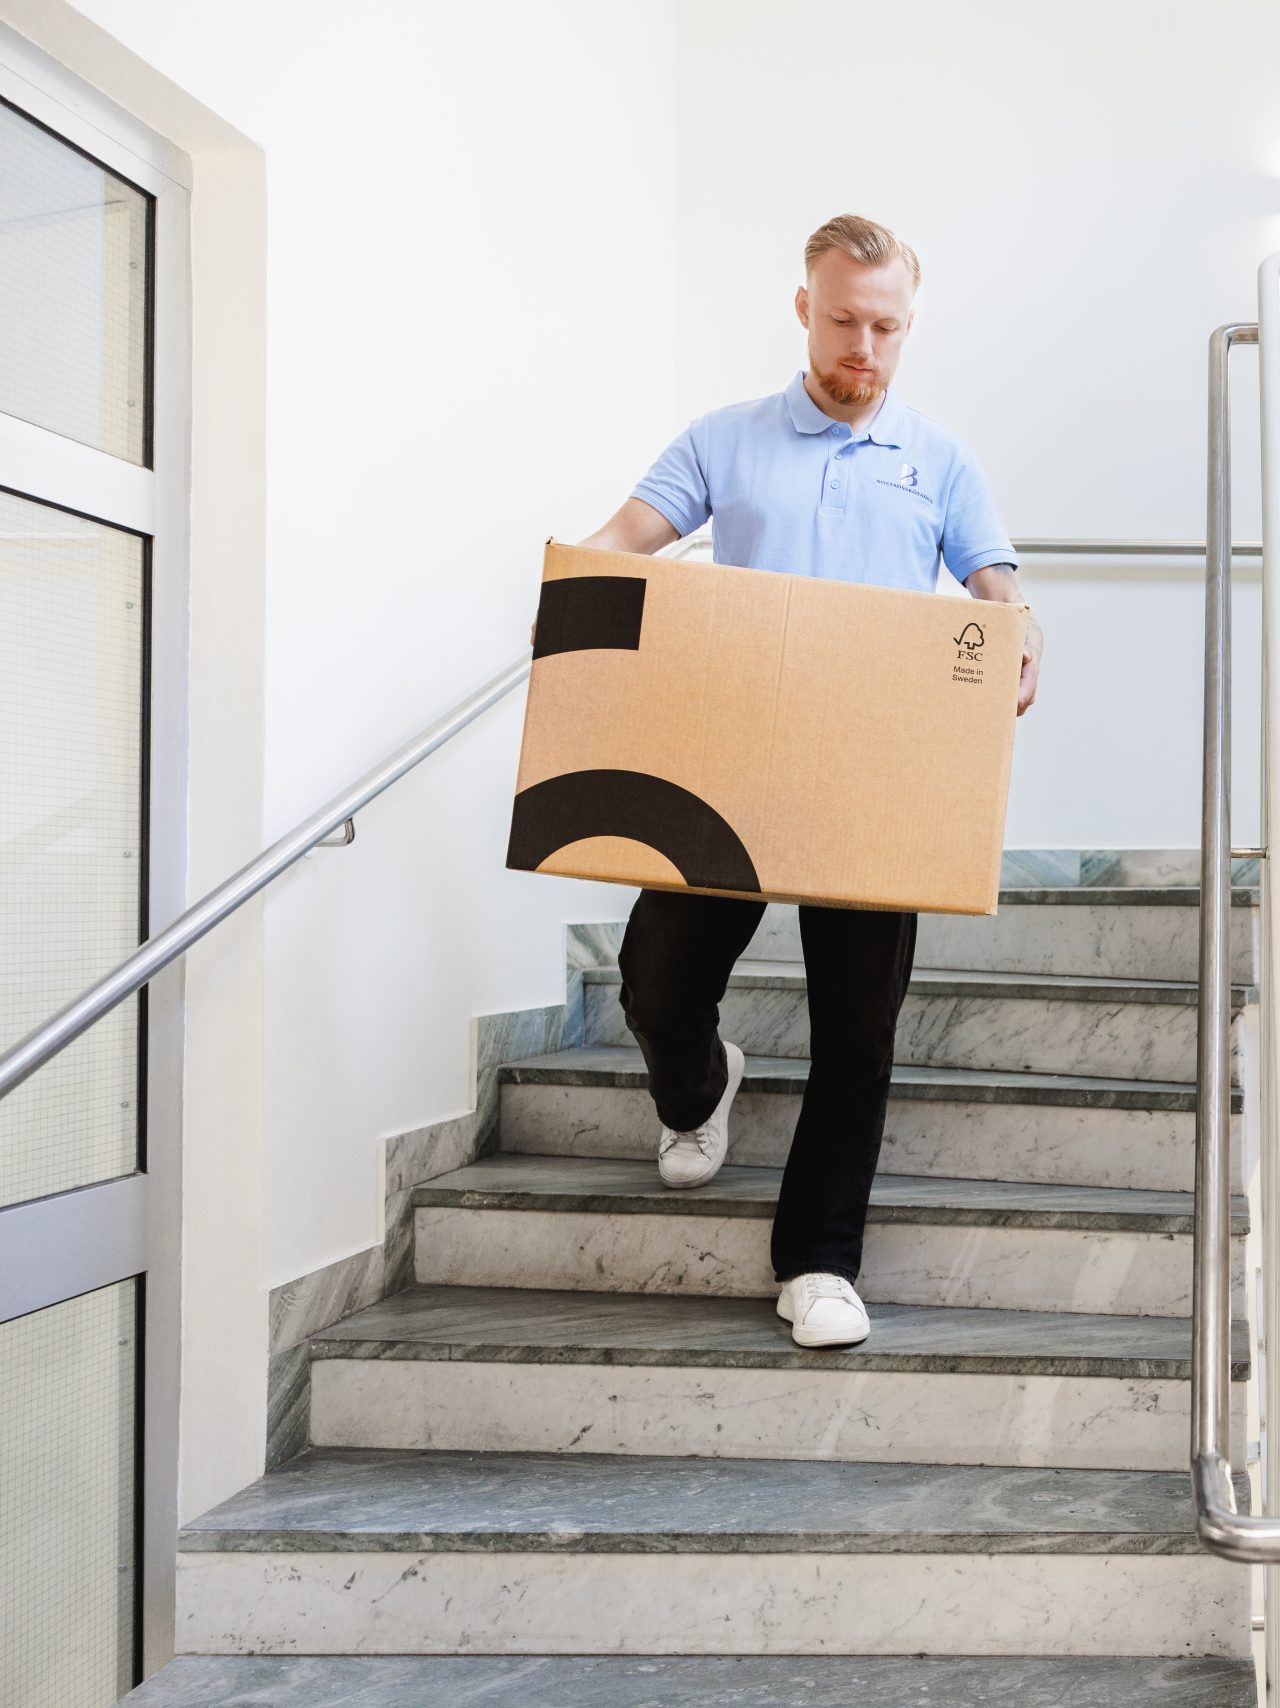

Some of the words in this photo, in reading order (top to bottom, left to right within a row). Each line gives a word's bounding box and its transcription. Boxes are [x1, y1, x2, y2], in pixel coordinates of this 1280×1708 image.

[957, 650, 983, 662] FSC
[953, 666, 975, 675] Made
[952, 674, 983, 684] Sweden
